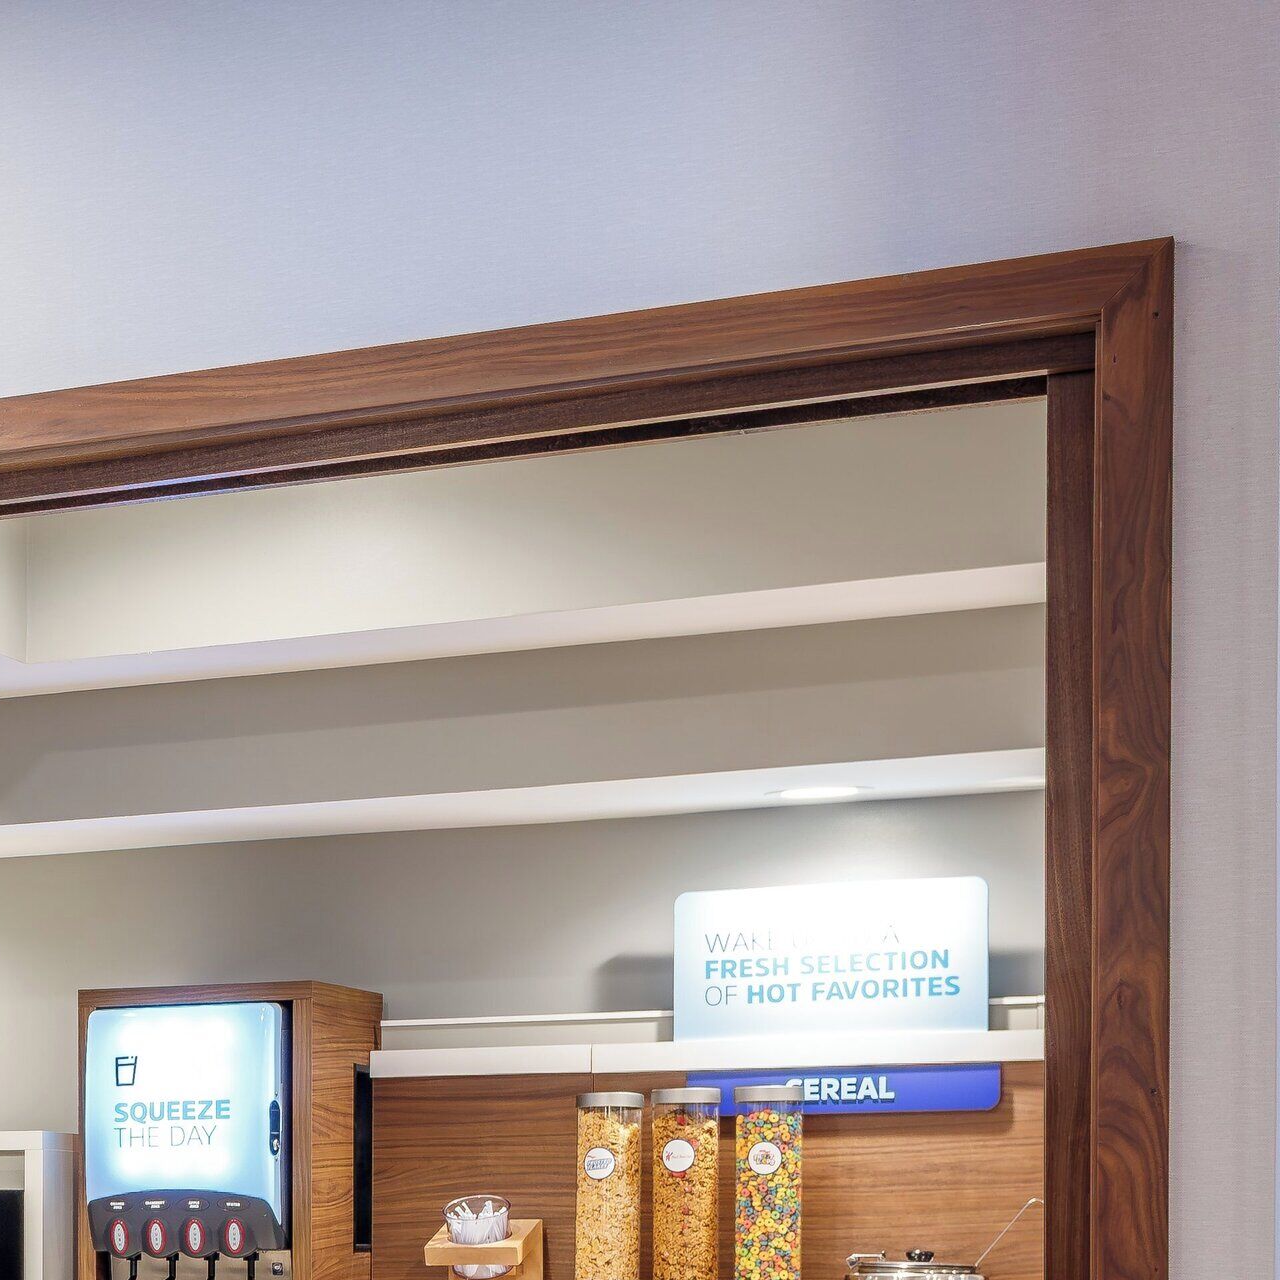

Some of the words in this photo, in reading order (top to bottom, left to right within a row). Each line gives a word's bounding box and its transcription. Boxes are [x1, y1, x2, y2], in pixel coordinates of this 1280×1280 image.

[705, 954, 789, 980] FRESH
[800, 949, 950, 975] SELECTION
[705, 984, 738, 1007] OF
[747, 983, 802, 1004] HOT
[811, 975, 961, 1001] FAVORITES
[114, 1099, 231, 1123] SQUEEZE
[114, 1125, 160, 1149] THE
[169, 1123, 218, 1148] DAY
